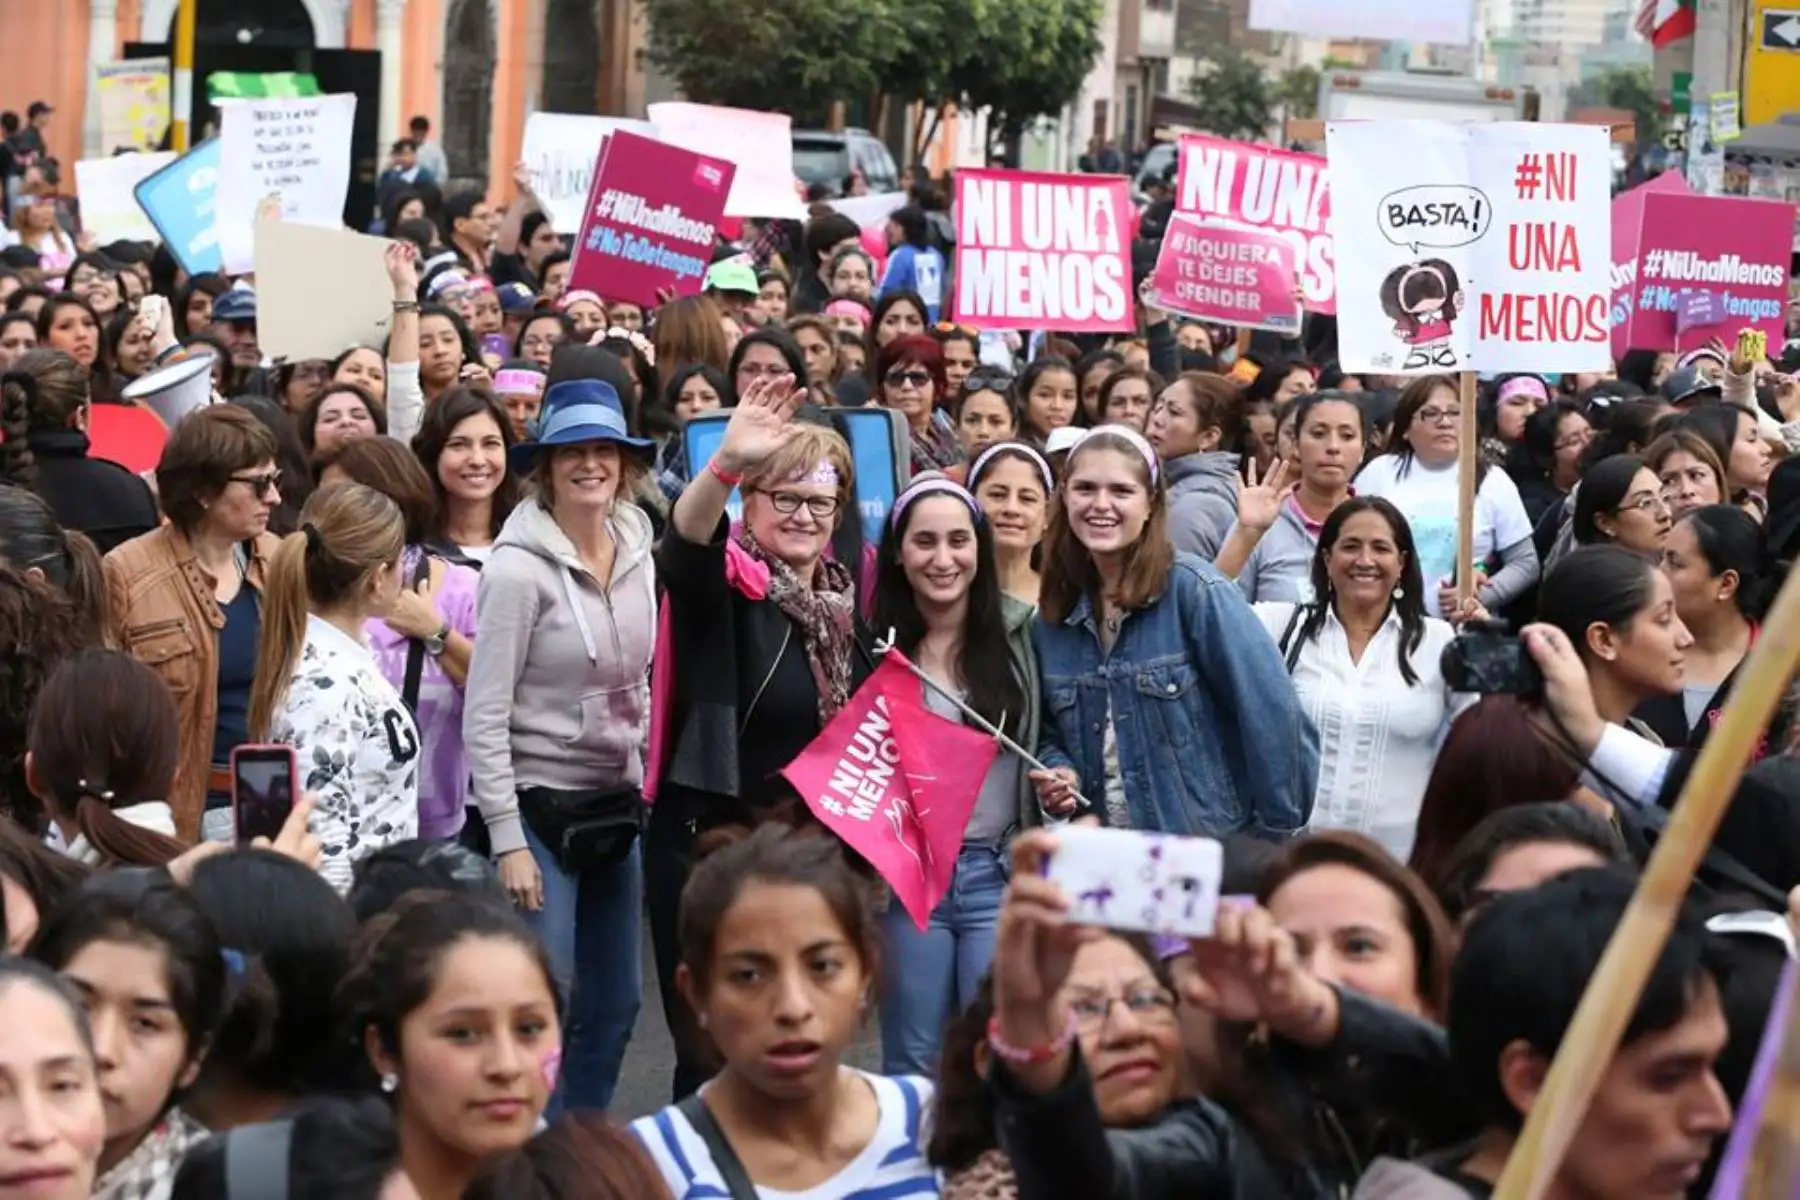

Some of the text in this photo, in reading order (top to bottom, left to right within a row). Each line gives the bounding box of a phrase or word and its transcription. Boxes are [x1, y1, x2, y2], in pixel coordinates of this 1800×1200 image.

[1182, 146, 1237, 216] NI
[1514, 152, 1577, 202] #NI
[596, 188, 714, 246] #NiUnaMenos
[962, 178, 1120, 253] NI UNA
[1176, 257, 1258, 287] TE DEJES
[1508, 221, 1581, 272] UNA
[1643, 248, 1785, 287] #NiUnaMenos
[959, 249, 1127, 322] MENOS
[1174, 281, 1262, 313] OFENDER
[1479, 292, 1609, 342] MENOS
[846, 738, 901, 822] MENO
